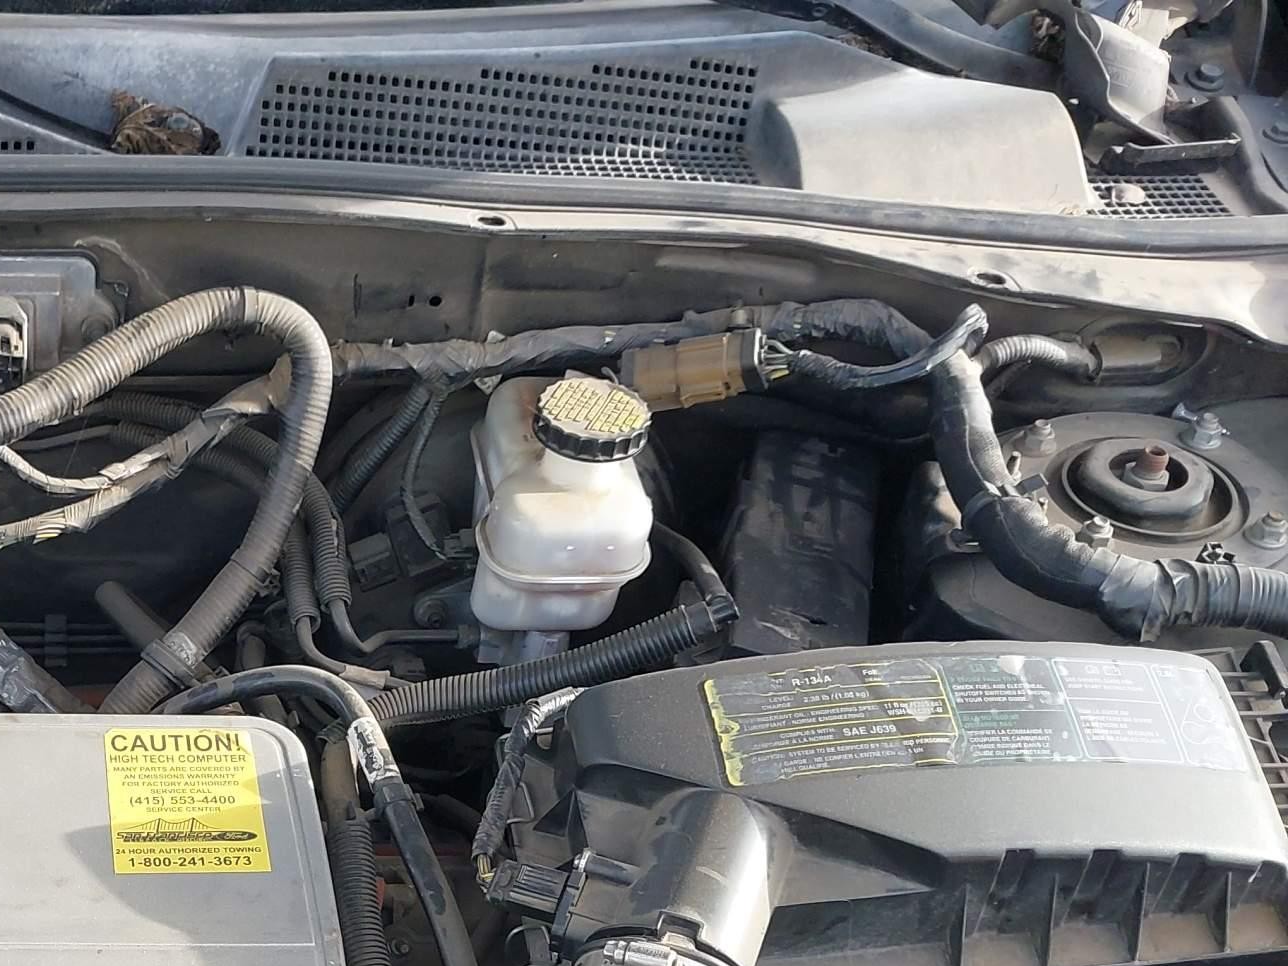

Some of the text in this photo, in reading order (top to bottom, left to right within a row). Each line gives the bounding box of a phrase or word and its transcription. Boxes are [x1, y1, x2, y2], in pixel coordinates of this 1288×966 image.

[792, 674, 832, 687] R-134A
[842, 724, 896, 736] SAE J639
[111, 733, 241, 752] CAUTION!
[110, 754, 246, 764] HIGH TECH COMPUTER
[130, 796, 236, 806] (415) 553-4400
[128, 856, 252, 868] 1-800-241-3673
